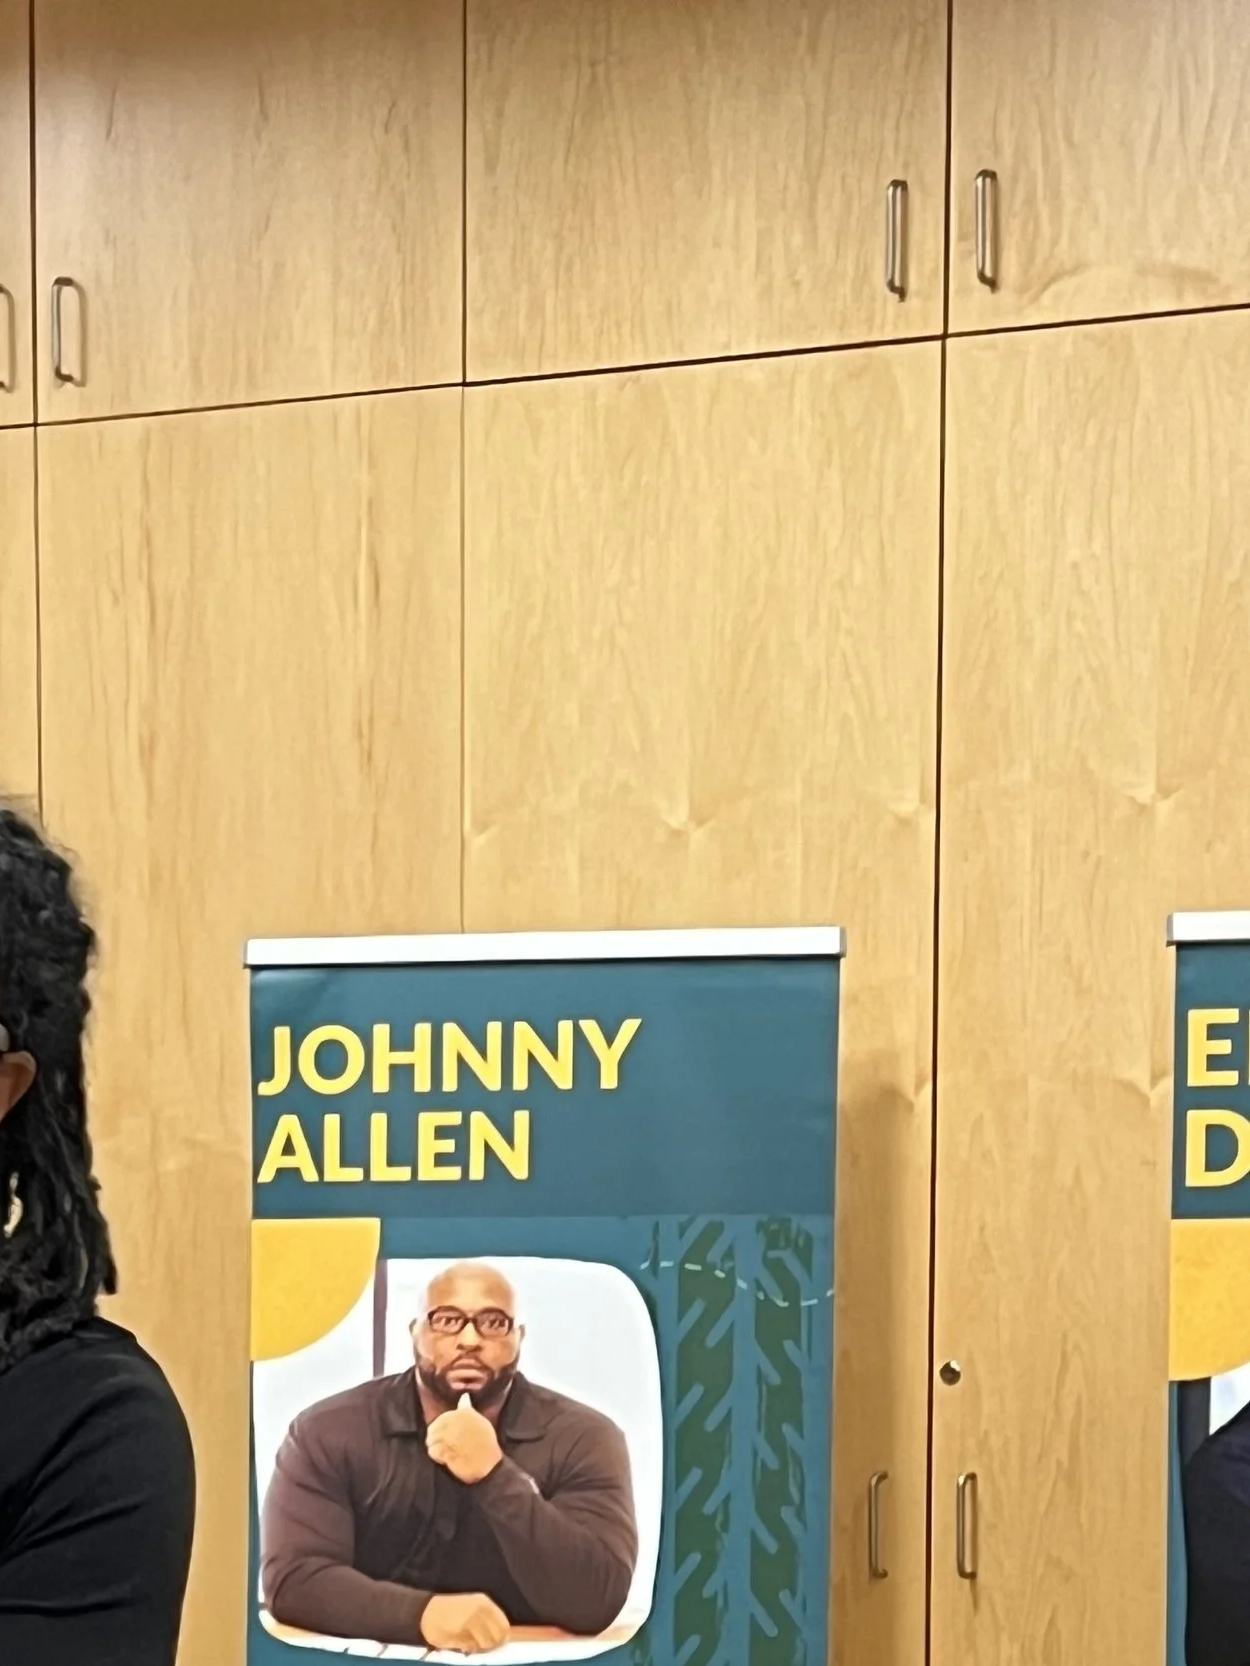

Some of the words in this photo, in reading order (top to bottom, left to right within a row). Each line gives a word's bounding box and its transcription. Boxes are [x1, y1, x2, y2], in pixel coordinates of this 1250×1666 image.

[257, 1018, 642, 1096] JOHNNY
[1187, 1008, 1250, 1086] E
[257, 1110, 530, 1183] ALLEN
